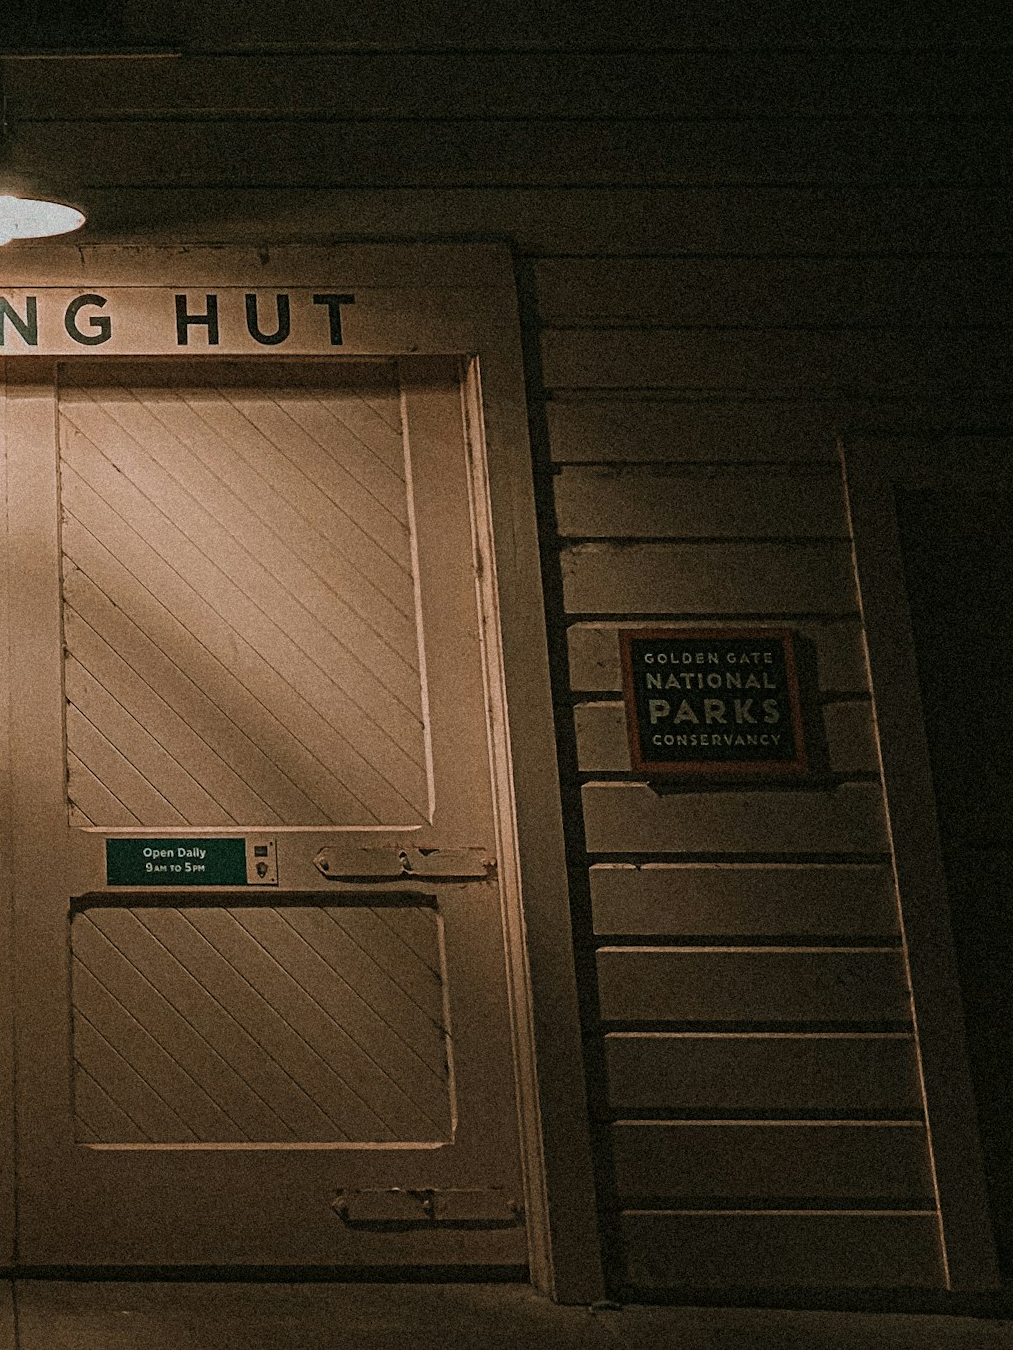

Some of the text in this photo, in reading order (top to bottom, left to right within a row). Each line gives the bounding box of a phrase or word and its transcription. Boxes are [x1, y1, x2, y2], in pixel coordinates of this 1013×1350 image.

[175, 293, 357, 346] HUT
[644, 652, 773, 664] GOLDEN GATE
[645, 672, 776, 689] NATIONAL
[648, 699, 780, 724] PARKS
[652, 734, 781, 746] CONSERVANCY
[142, 847, 206, 860] Open Daily
